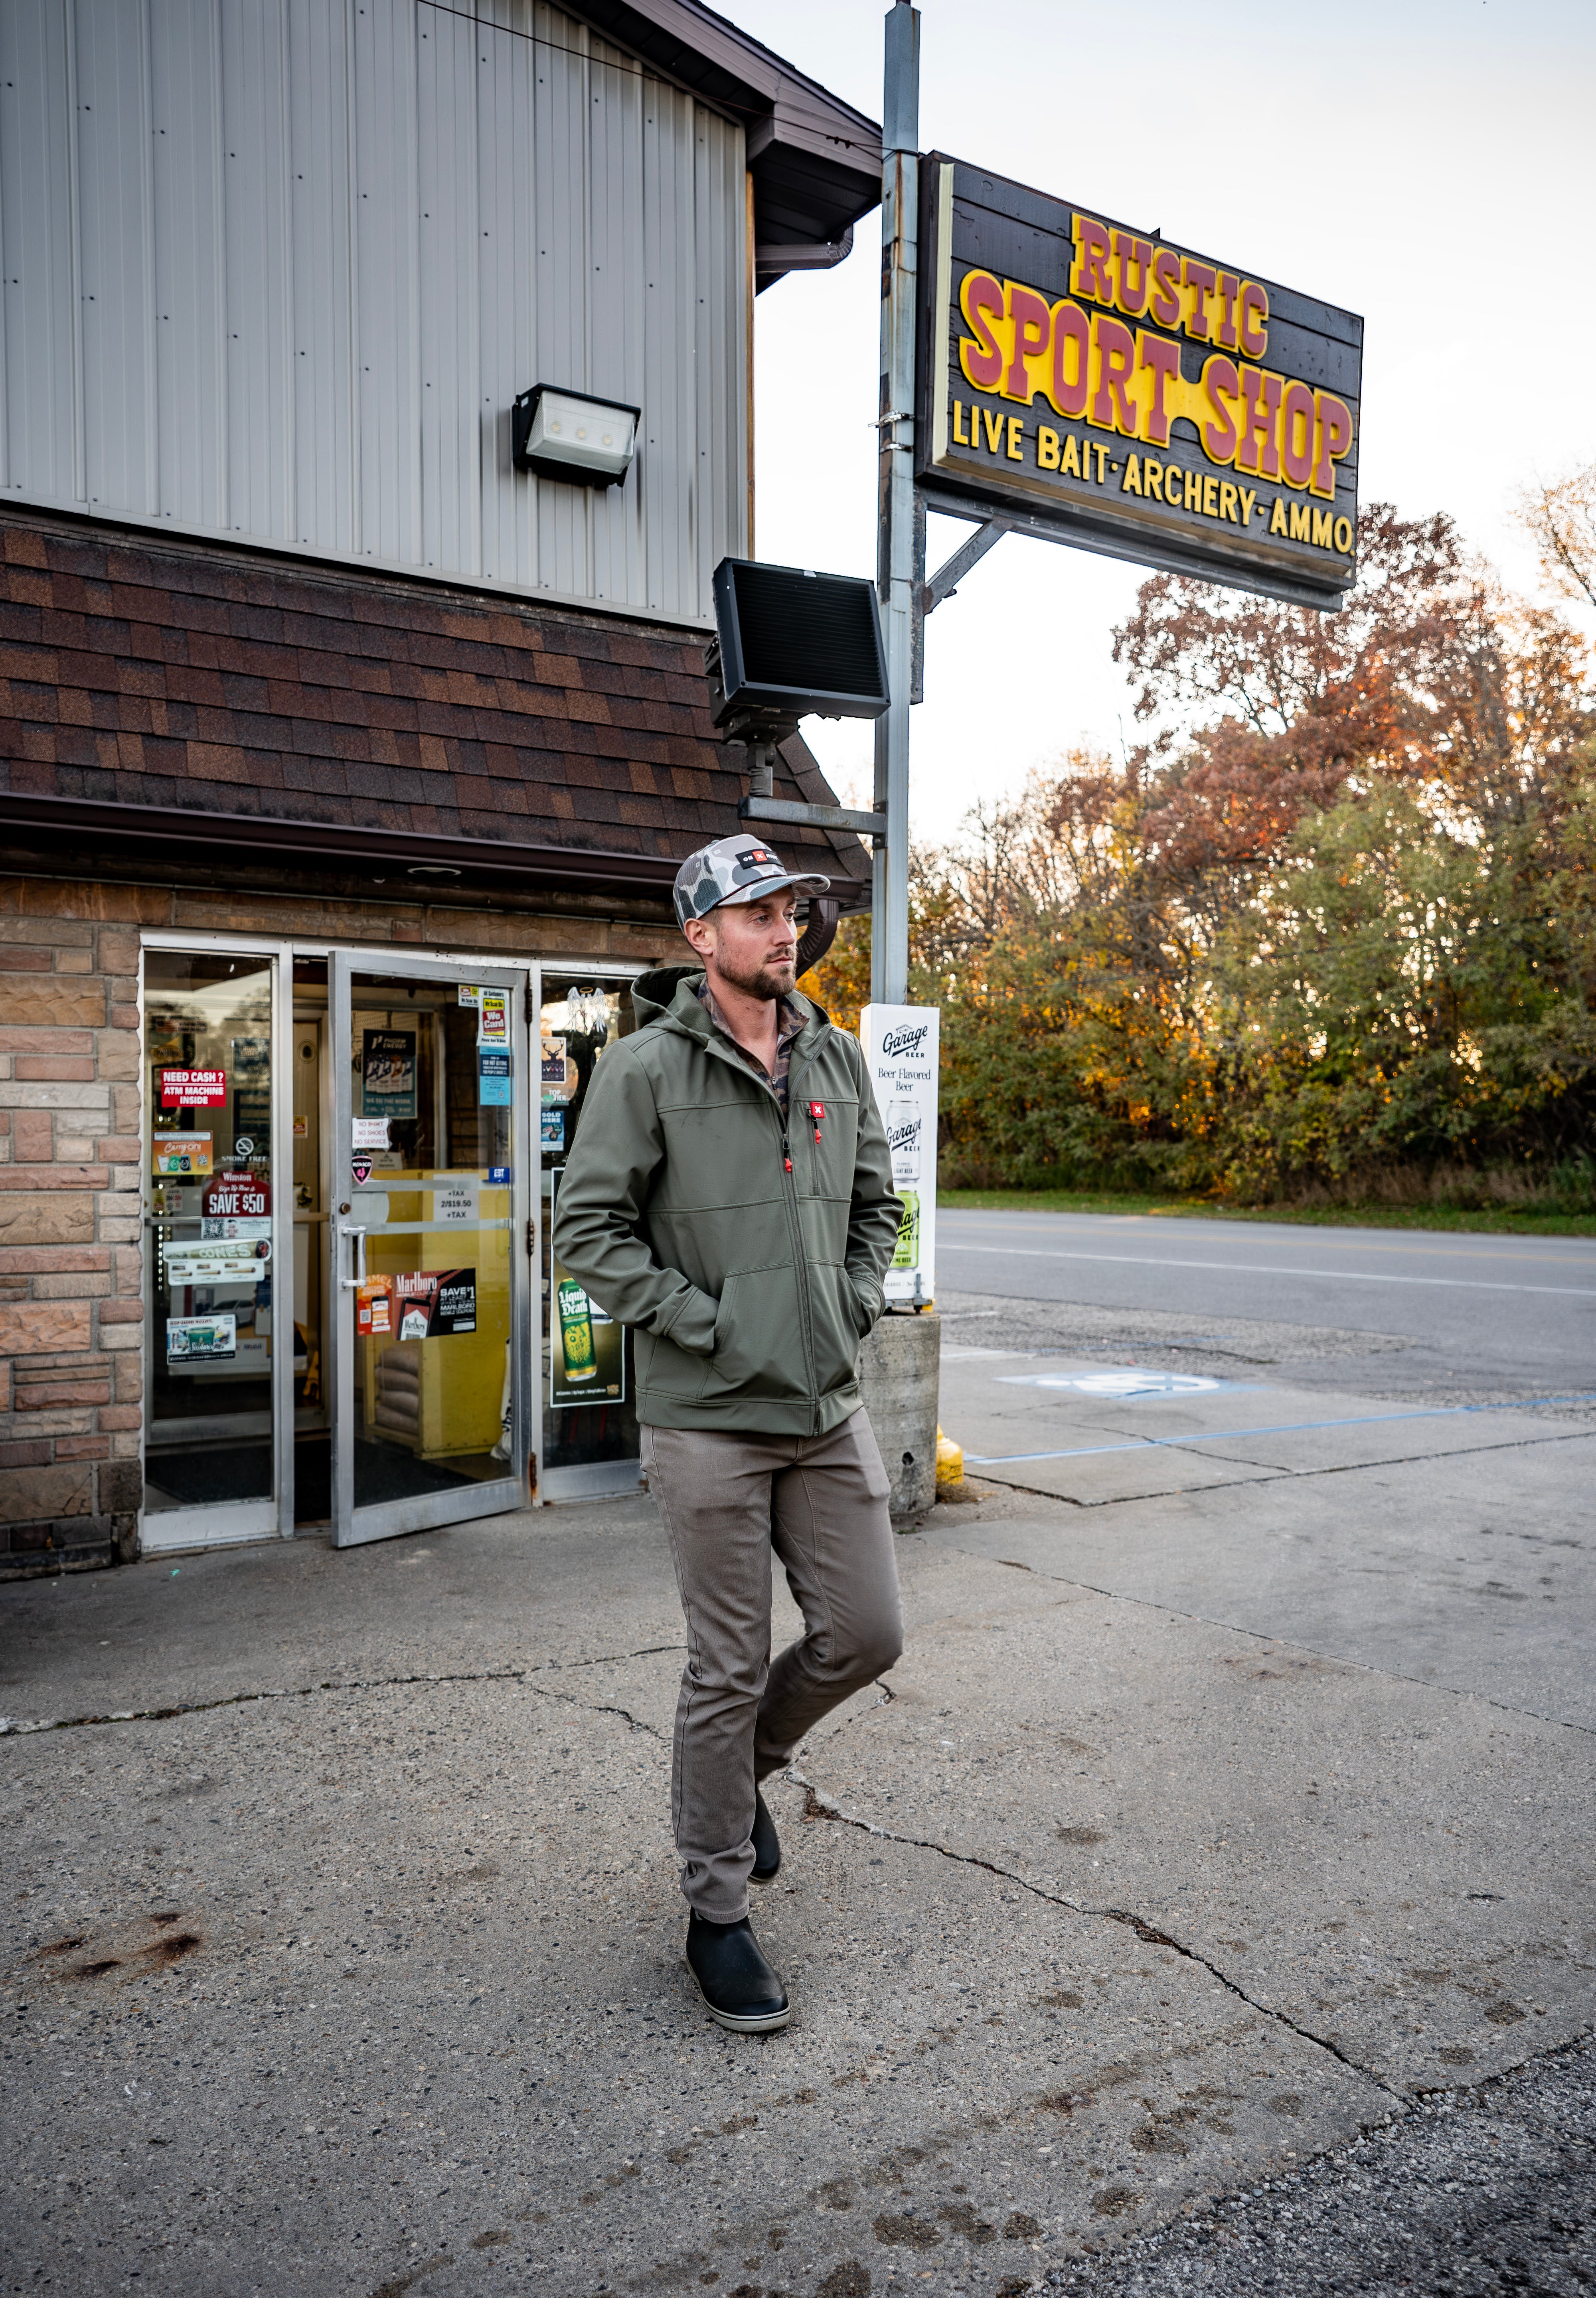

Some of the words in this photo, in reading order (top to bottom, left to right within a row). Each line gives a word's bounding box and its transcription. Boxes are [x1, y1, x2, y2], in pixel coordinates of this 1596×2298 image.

[1071, 213, 1269, 359] RUSTIC
[961, 271, 1180, 446] SPORT
[1202, 355, 1353, 499] SHOP
[953, 400, 1024, 461] LIVE
[486, 1011, 501, 1020] We
[484, 1019, 504, 1029] Card
[883, 1026, 928, 1056] Garage
[163, 1072, 189, 1082] NEED
[191, 1072, 216, 1082] CASH
[217, 1072, 223, 1083] ?
[879, 1067, 896, 1078] Beer
[899, 1068, 930, 1080] Flavored
[164, 1086, 183, 1095] ATM
[185, 1087, 224, 1095] MACHINE
[896, 1081, 913, 1091] Beer
[180, 1096, 208, 1105] INSIDE
[223, 1172, 252, 1182] Winston
[494, 1168, 504, 1178] EBT
[209, 1193, 240, 1214] SAVE
[242, 1193, 265, 1214] $50
[440, 1199, 472, 1208] 2/$19.50
[199, 1243, 252, 1258] CONES
[366, 1274, 392, 1288] AMEL
[396, 1271, 437, 1293] Marlboro
[440, 1287, 466, 1297] SAVE
[559, 1287, 587, 1305] Liquid
[561, 1299, 588, 1316] Death
